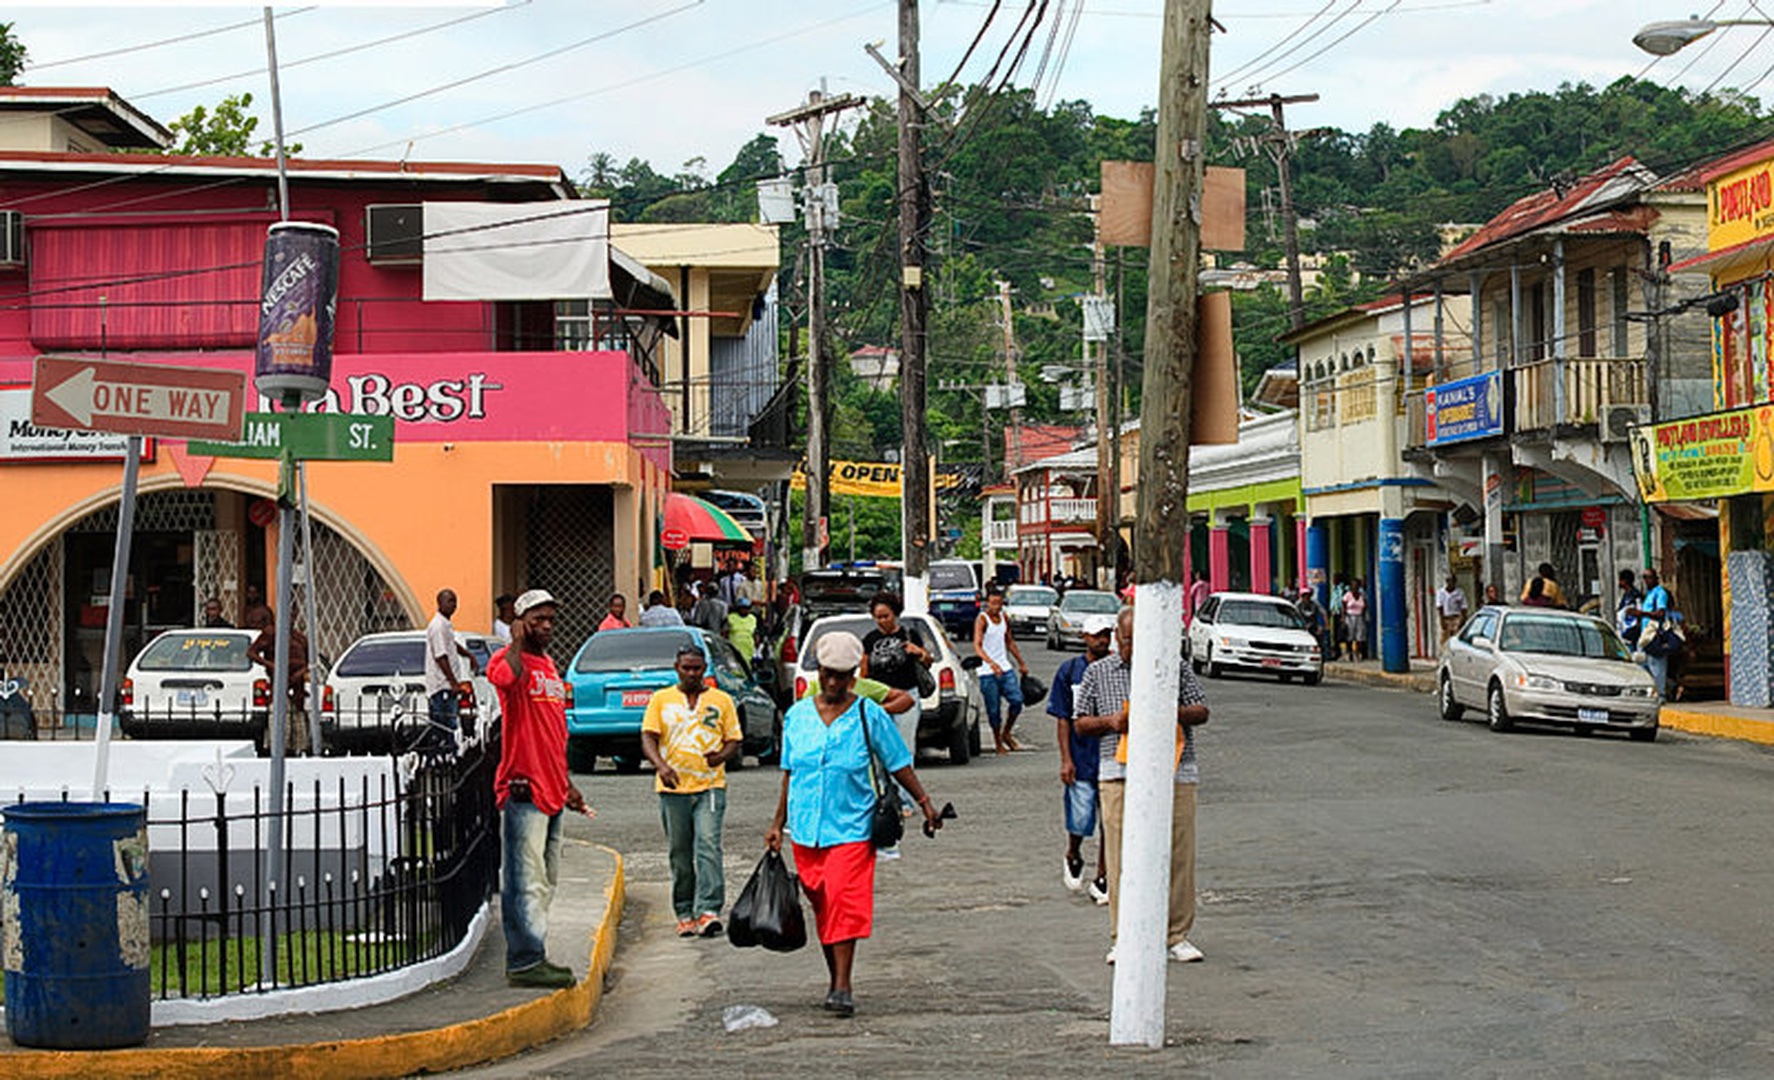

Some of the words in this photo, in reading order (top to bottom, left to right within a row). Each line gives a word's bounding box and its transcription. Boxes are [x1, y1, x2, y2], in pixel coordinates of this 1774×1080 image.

[262, 252, 316, 315] NESCAFÉ
[93, 384, 152, 415] ONE
[168, 389, 220, 419] WAY
[349, 423, 377, 449] ST.
[841, 455, 899, 482] OPEN
[702, 706, 720, 728] 2
